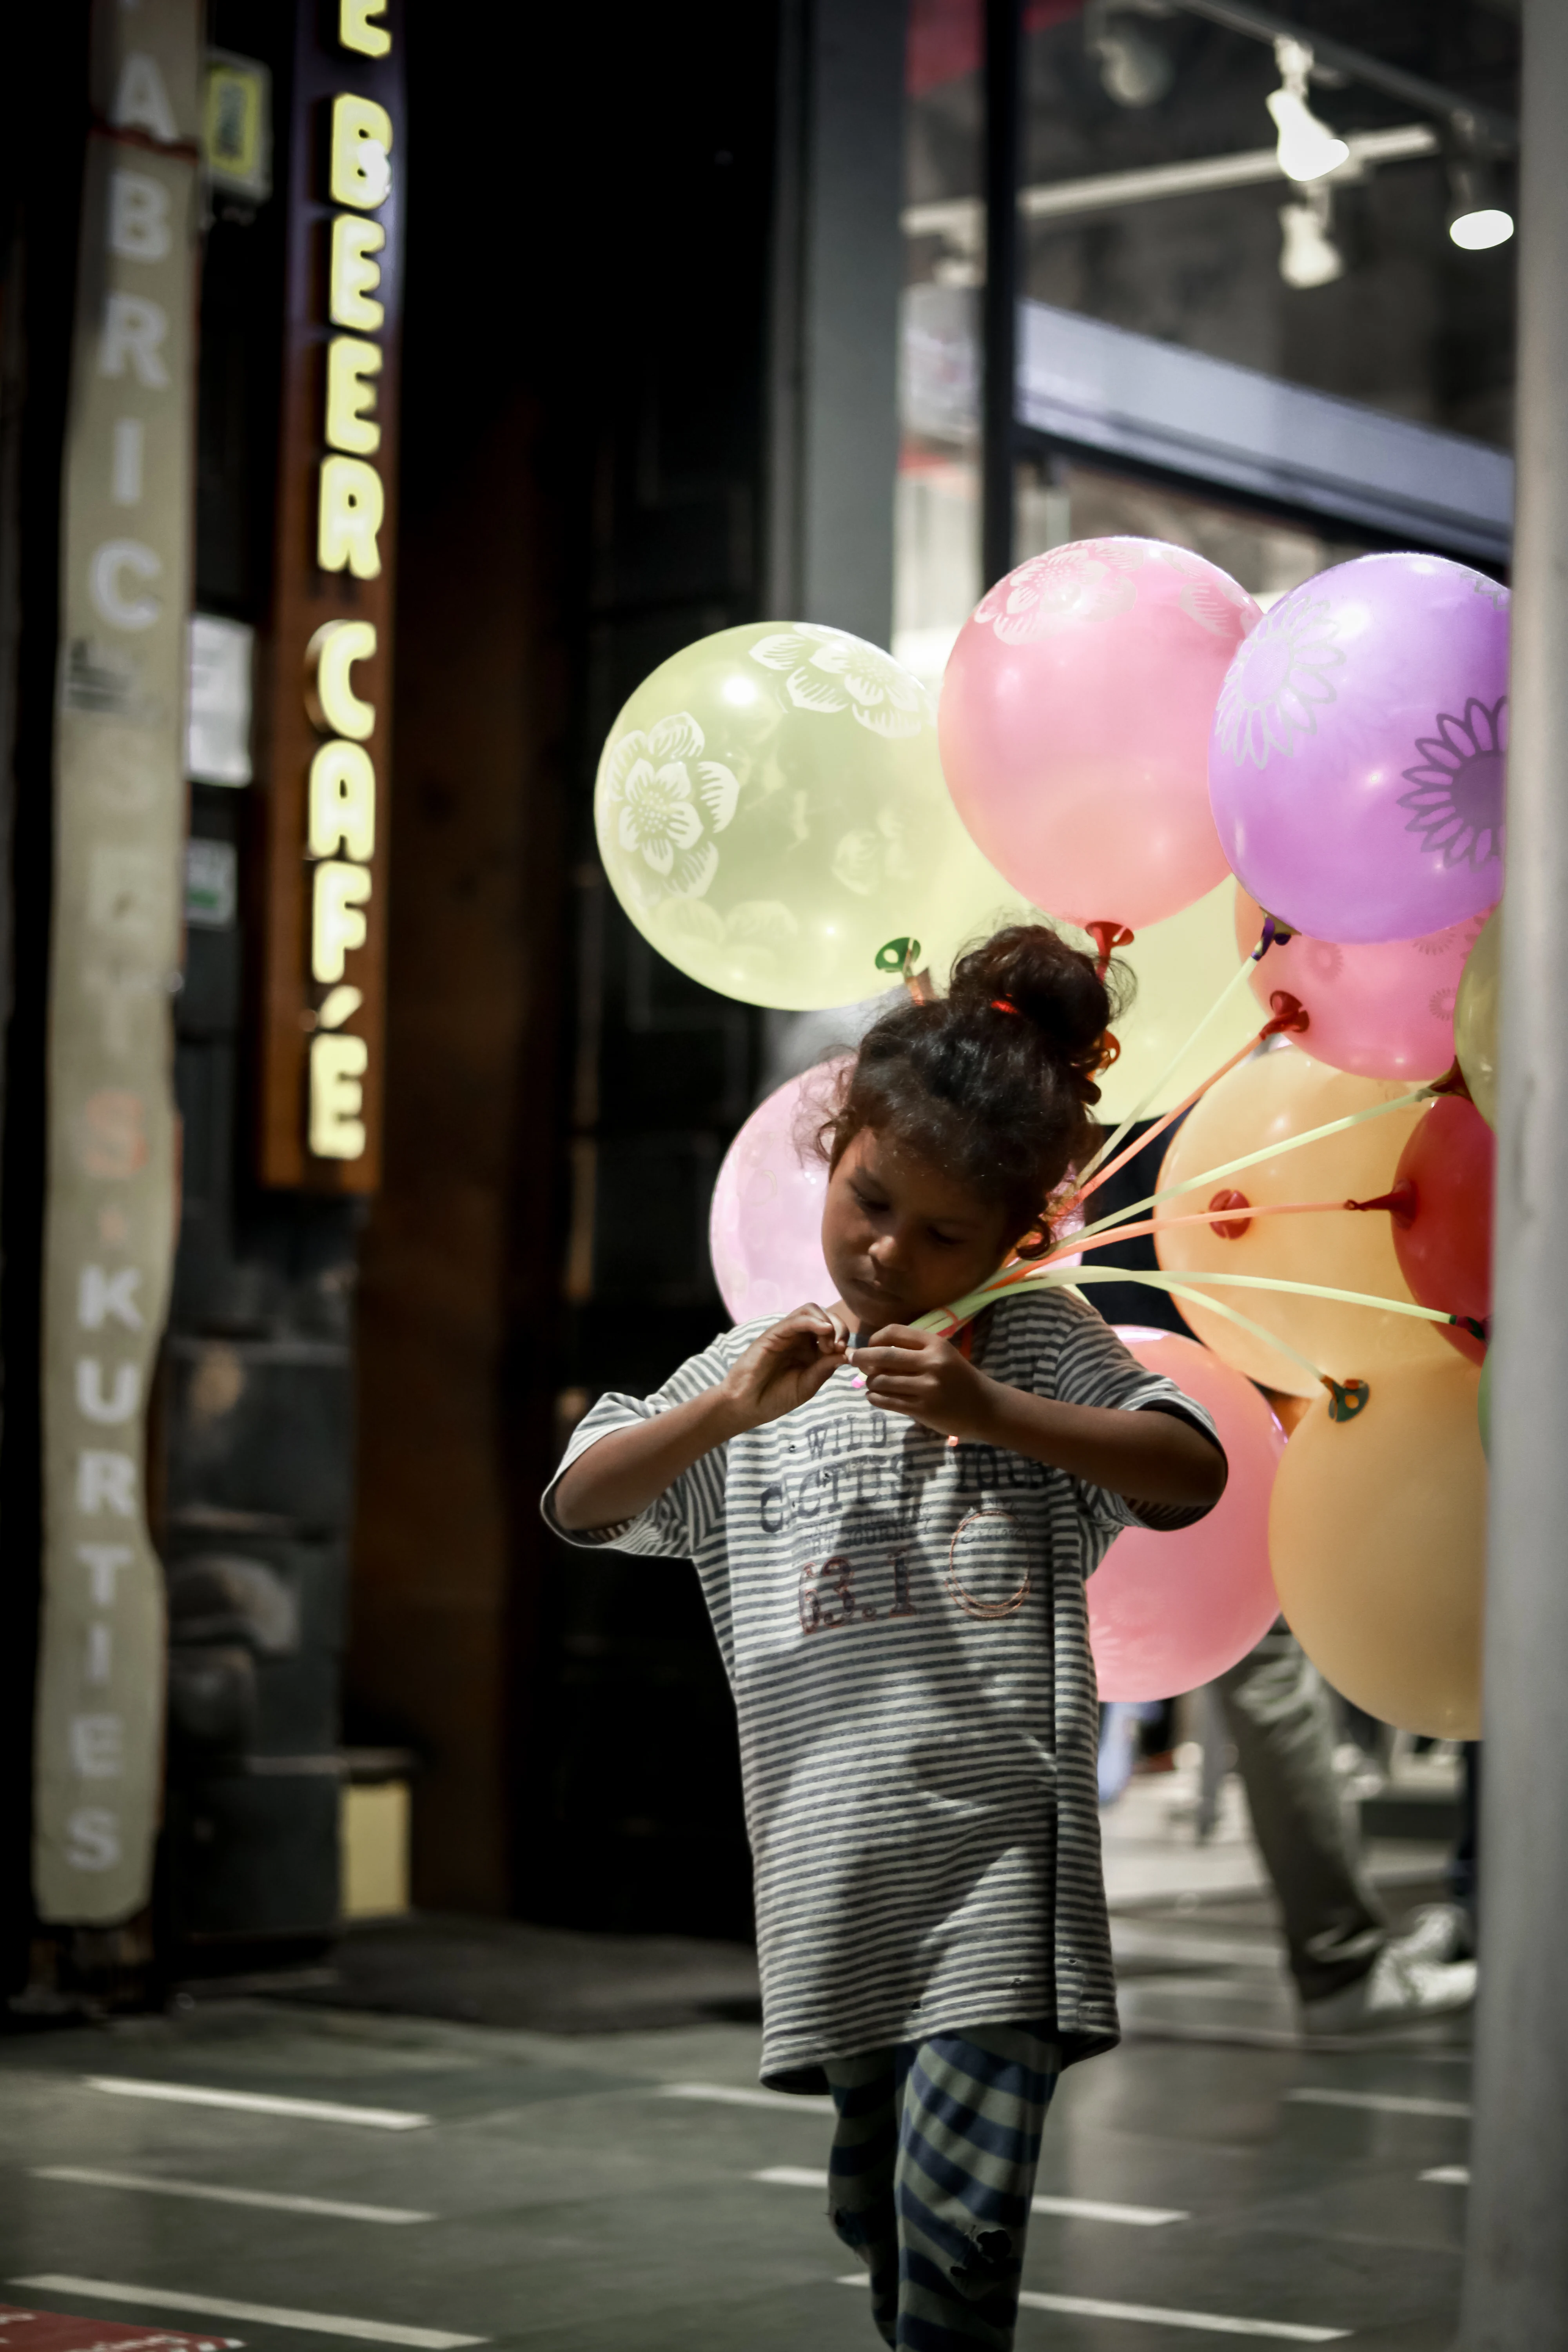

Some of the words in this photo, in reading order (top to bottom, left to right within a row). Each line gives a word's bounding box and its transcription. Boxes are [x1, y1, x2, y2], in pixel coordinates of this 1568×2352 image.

[90, 0, 180, 626] ABRIC
[317, 93, 393, 581] BEER
[66, 1264, 143, 1873] KURTIES
[805, 1411, 888, 1461] WILD
